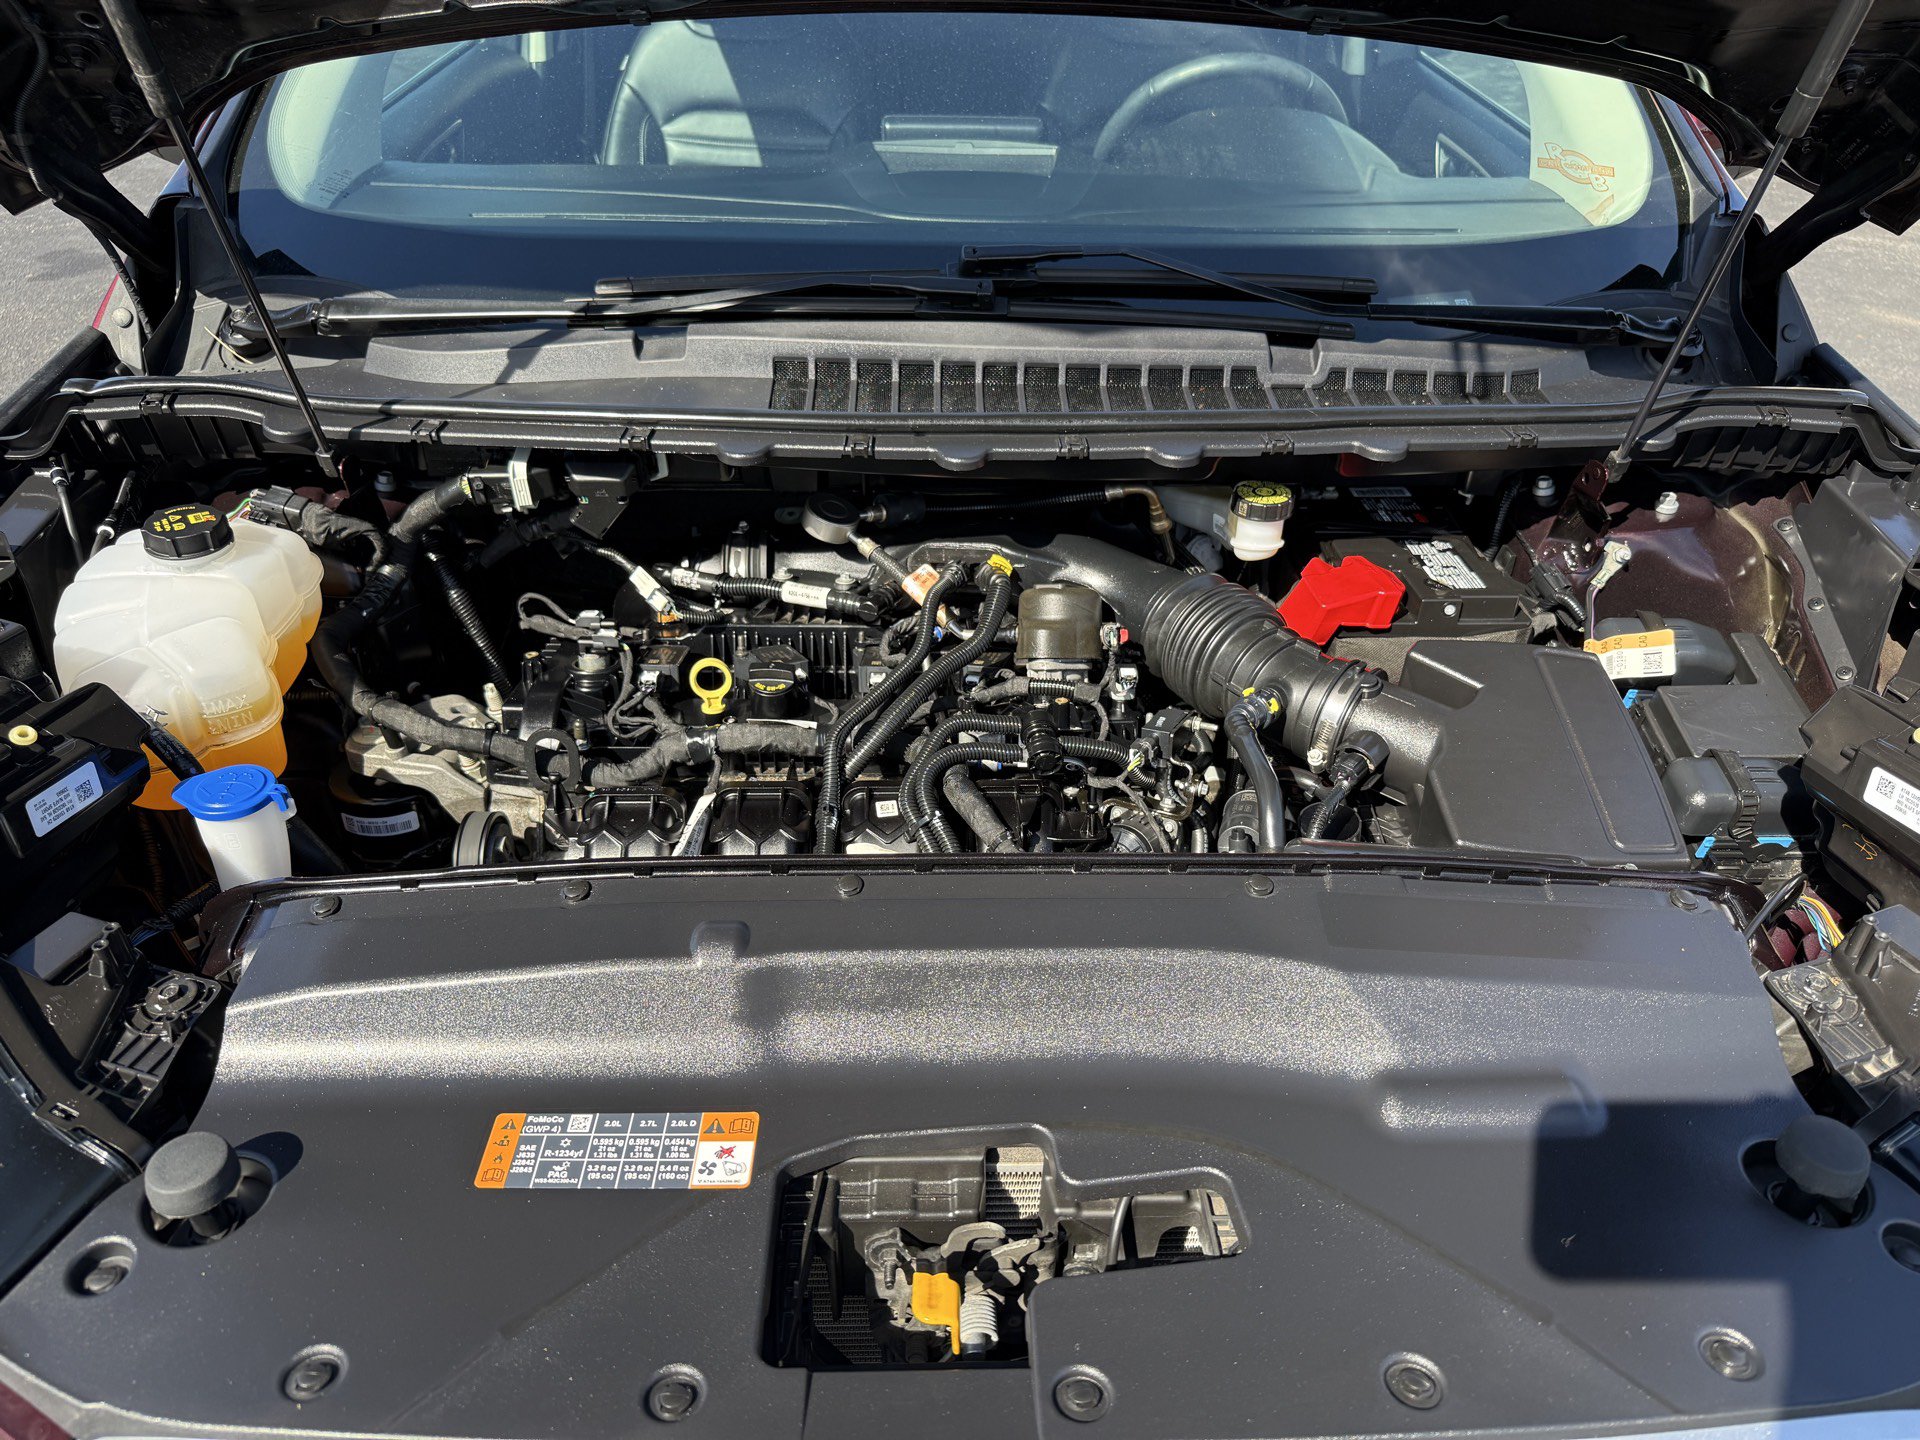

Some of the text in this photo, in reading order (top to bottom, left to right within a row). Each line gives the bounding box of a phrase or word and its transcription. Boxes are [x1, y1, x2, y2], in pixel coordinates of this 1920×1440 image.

[211, 694, 250, 715] MAX
[217, 710, 254, 732] MIN
[527, 1115, 565, 1123] FoMoCo
[522, 1125, 561, 1134] (GWP 4)
[592, 1138, 625, 1147] 0.595 kg
[628, 1138, 660, 1147] 0.595 kg
[664, 1138, 696, 1147] 0.454 kg
[544, 1150, 584, 1158] R-1234yf
[588, 1172, 614, 1180] (95 cc)
[624, 1172, 651, 1180] (95 cc)
[676, 1172, 689, 1180] cc)
